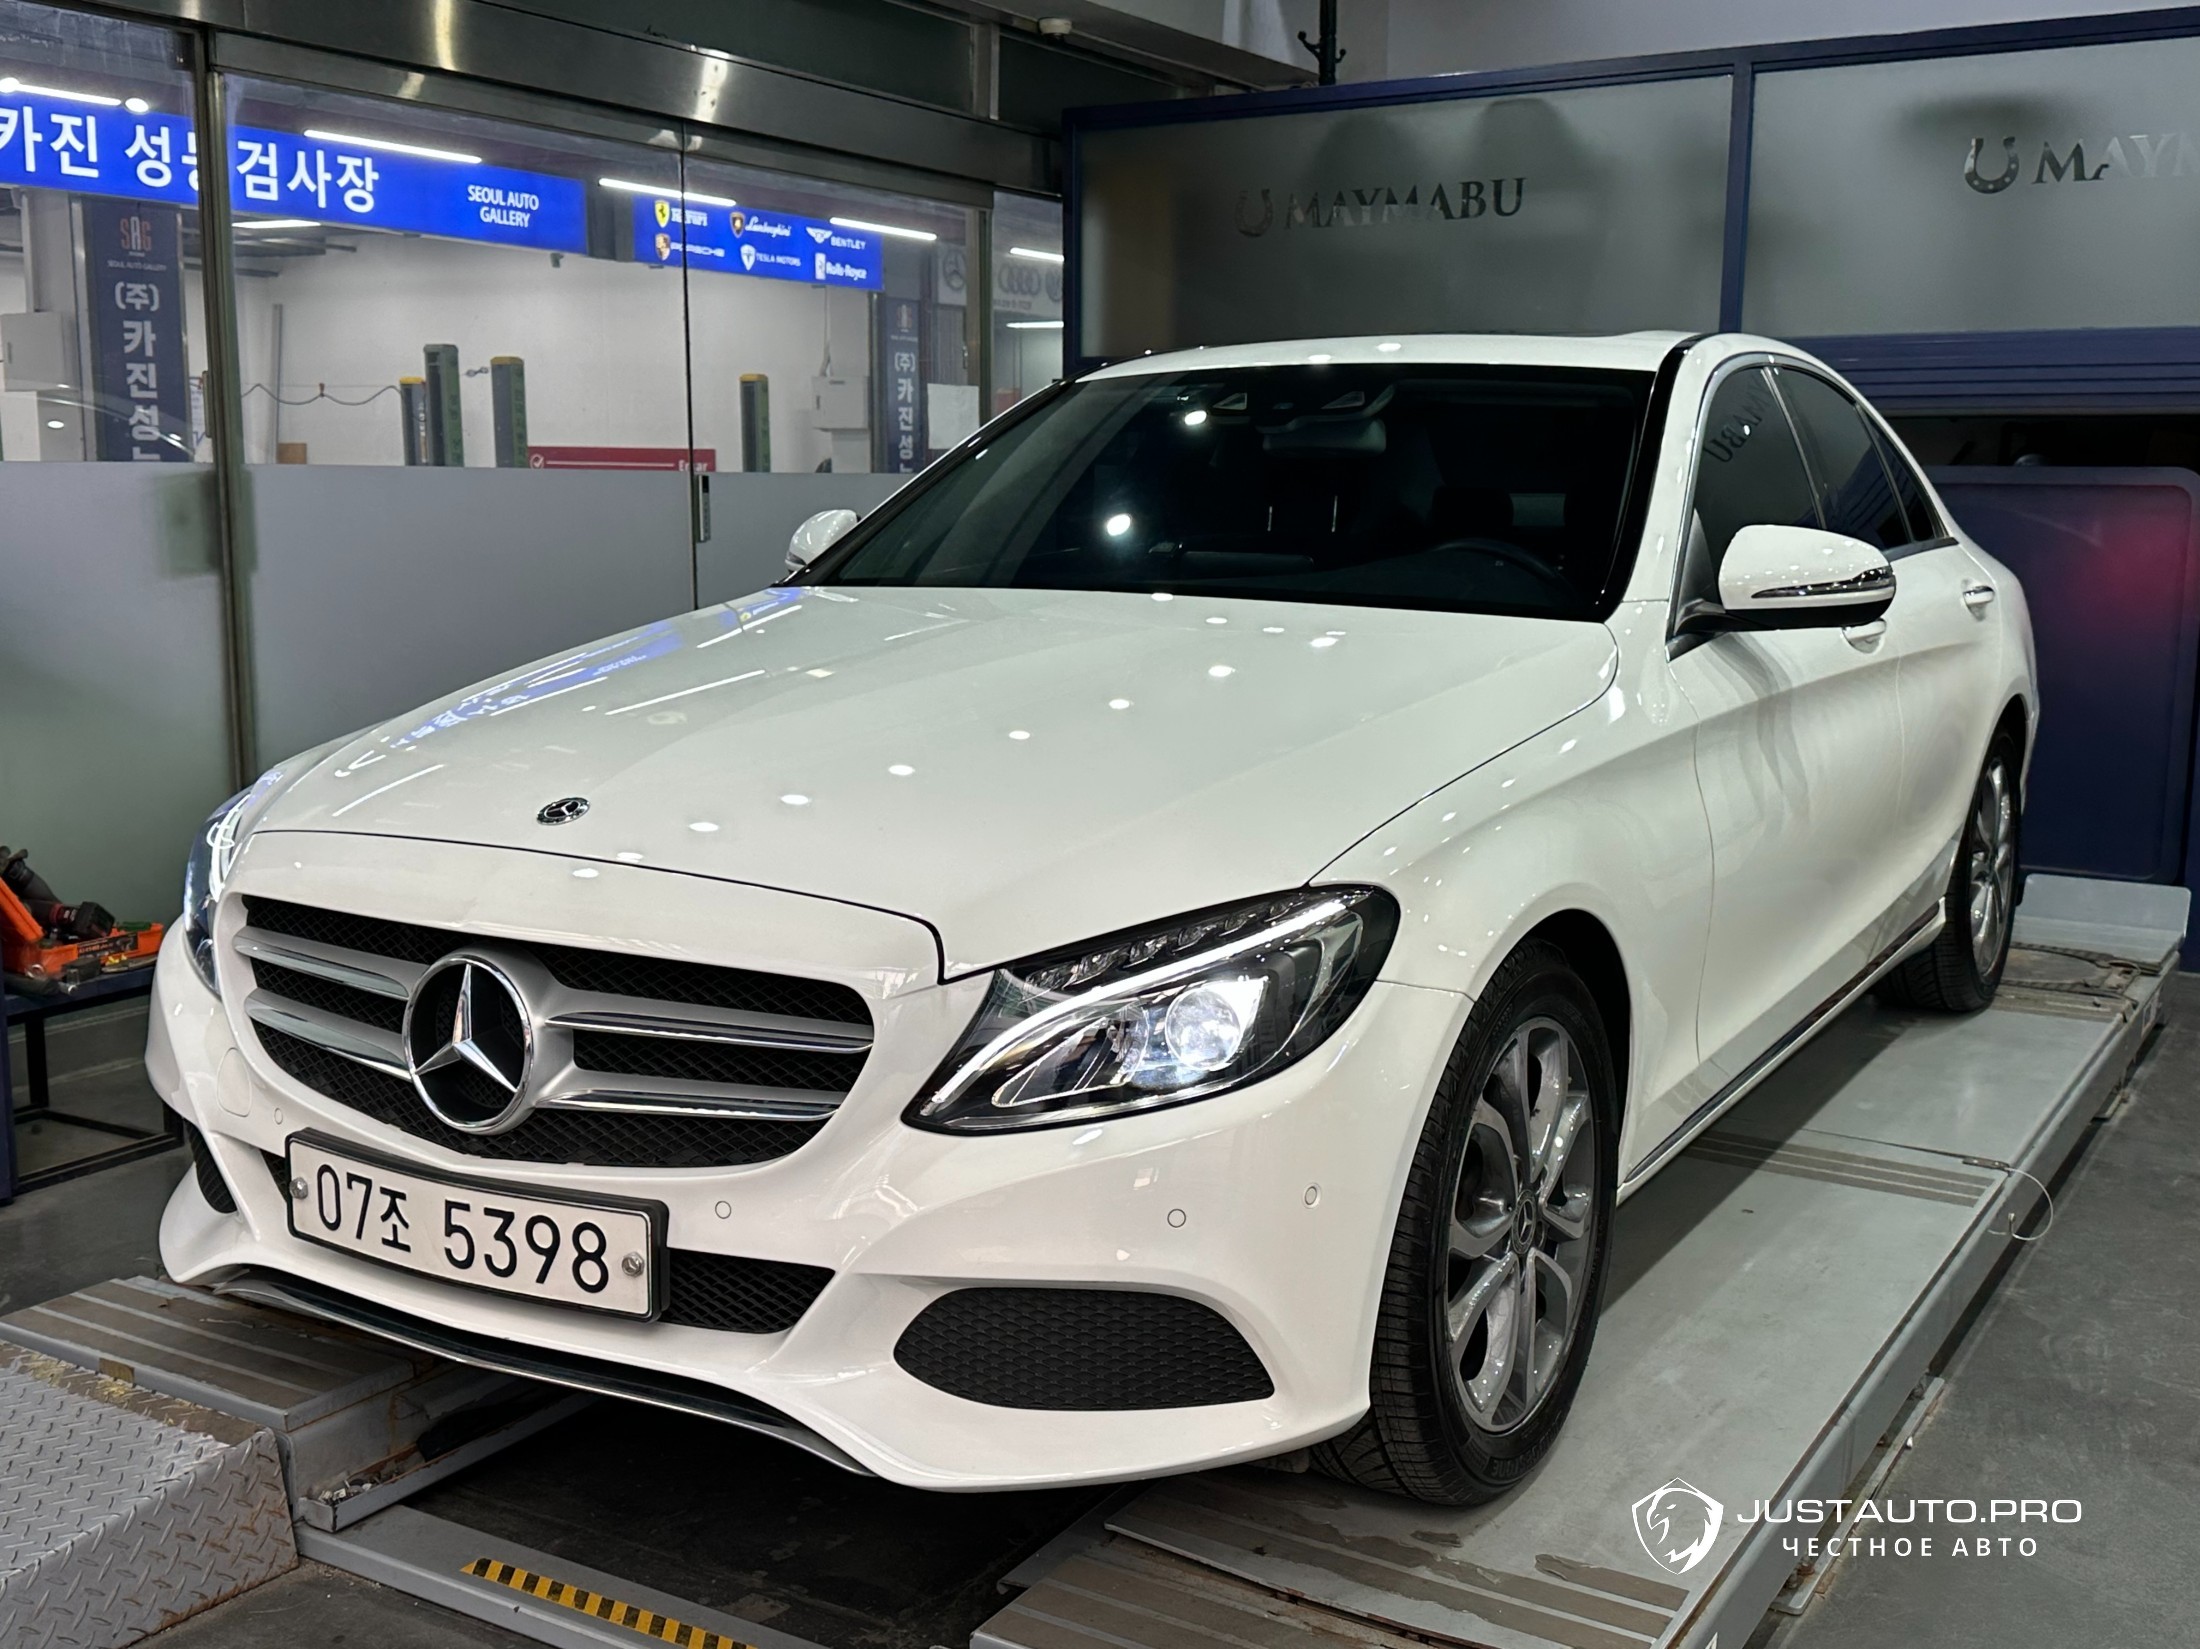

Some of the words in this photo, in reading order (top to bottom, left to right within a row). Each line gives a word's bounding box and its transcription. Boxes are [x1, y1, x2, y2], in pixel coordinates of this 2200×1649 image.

[0, 105, 99, 178] 카진
[467, 184, 506, 206] SEOUL
[506, 192, 540, 211] AUTO
[479, 206, 530, 228] GALLERY
[1284, 177, 1527, 230] MAYMABU
[830, 236, 867, 250] BENTLEY
[316, 1164, 412, 1253] 07조
[443, 1198, 609, 1294] 5398
